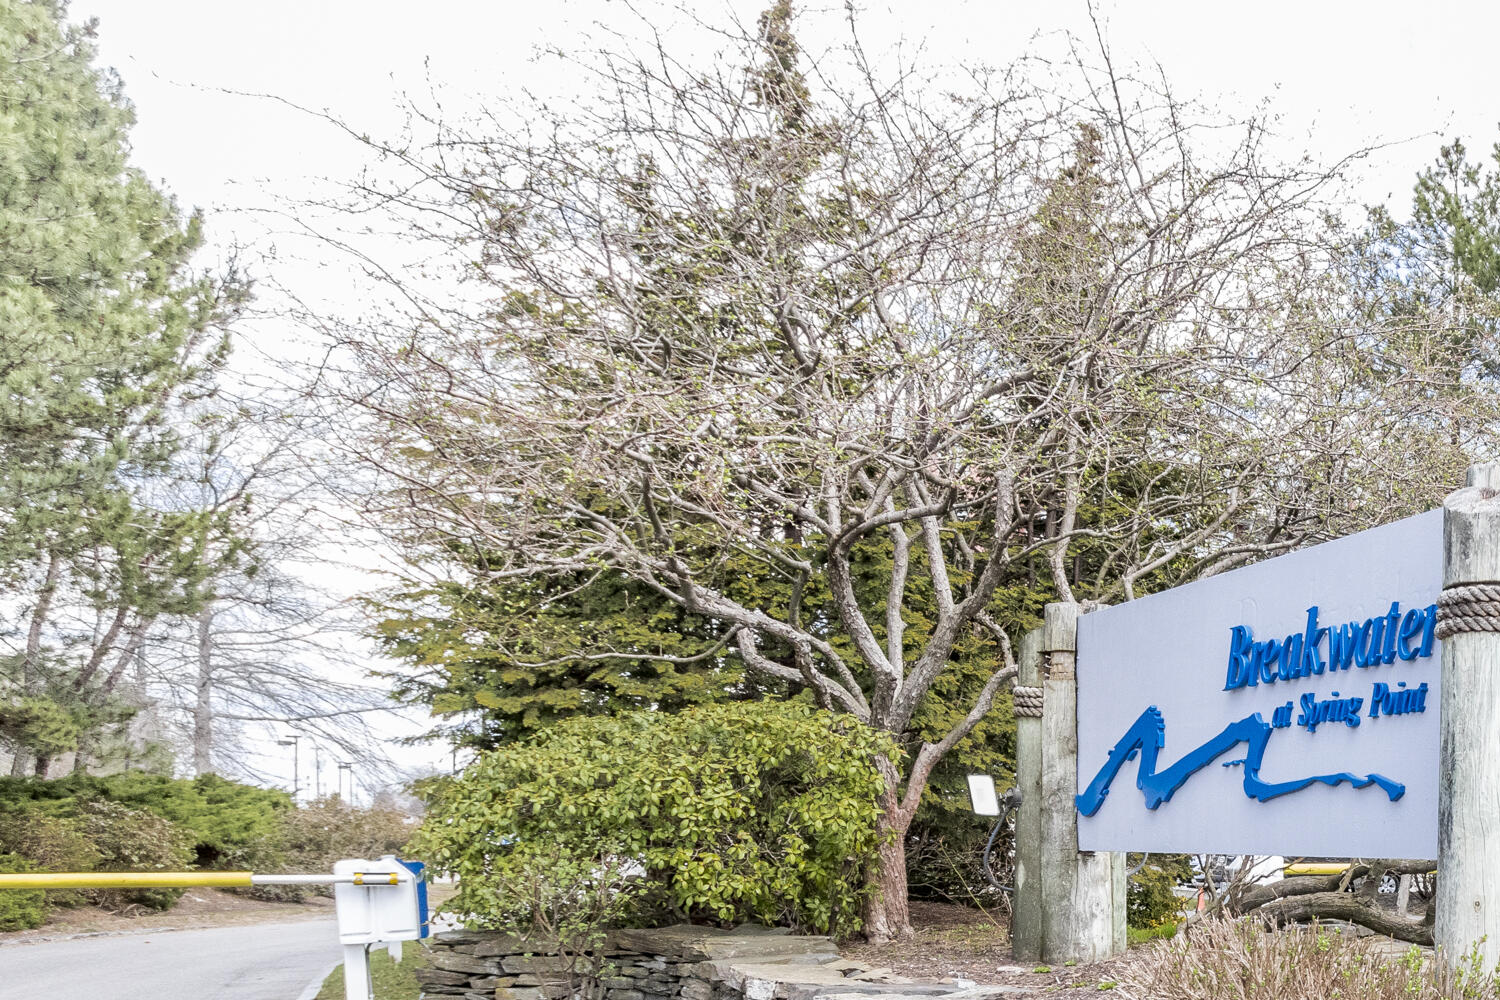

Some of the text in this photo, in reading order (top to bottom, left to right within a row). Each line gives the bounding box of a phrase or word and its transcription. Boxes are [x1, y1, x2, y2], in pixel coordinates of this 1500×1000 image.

[1222, 602, 1438, 691] Breakwater
[1272, 682, 1429, 733] at Spring Point
